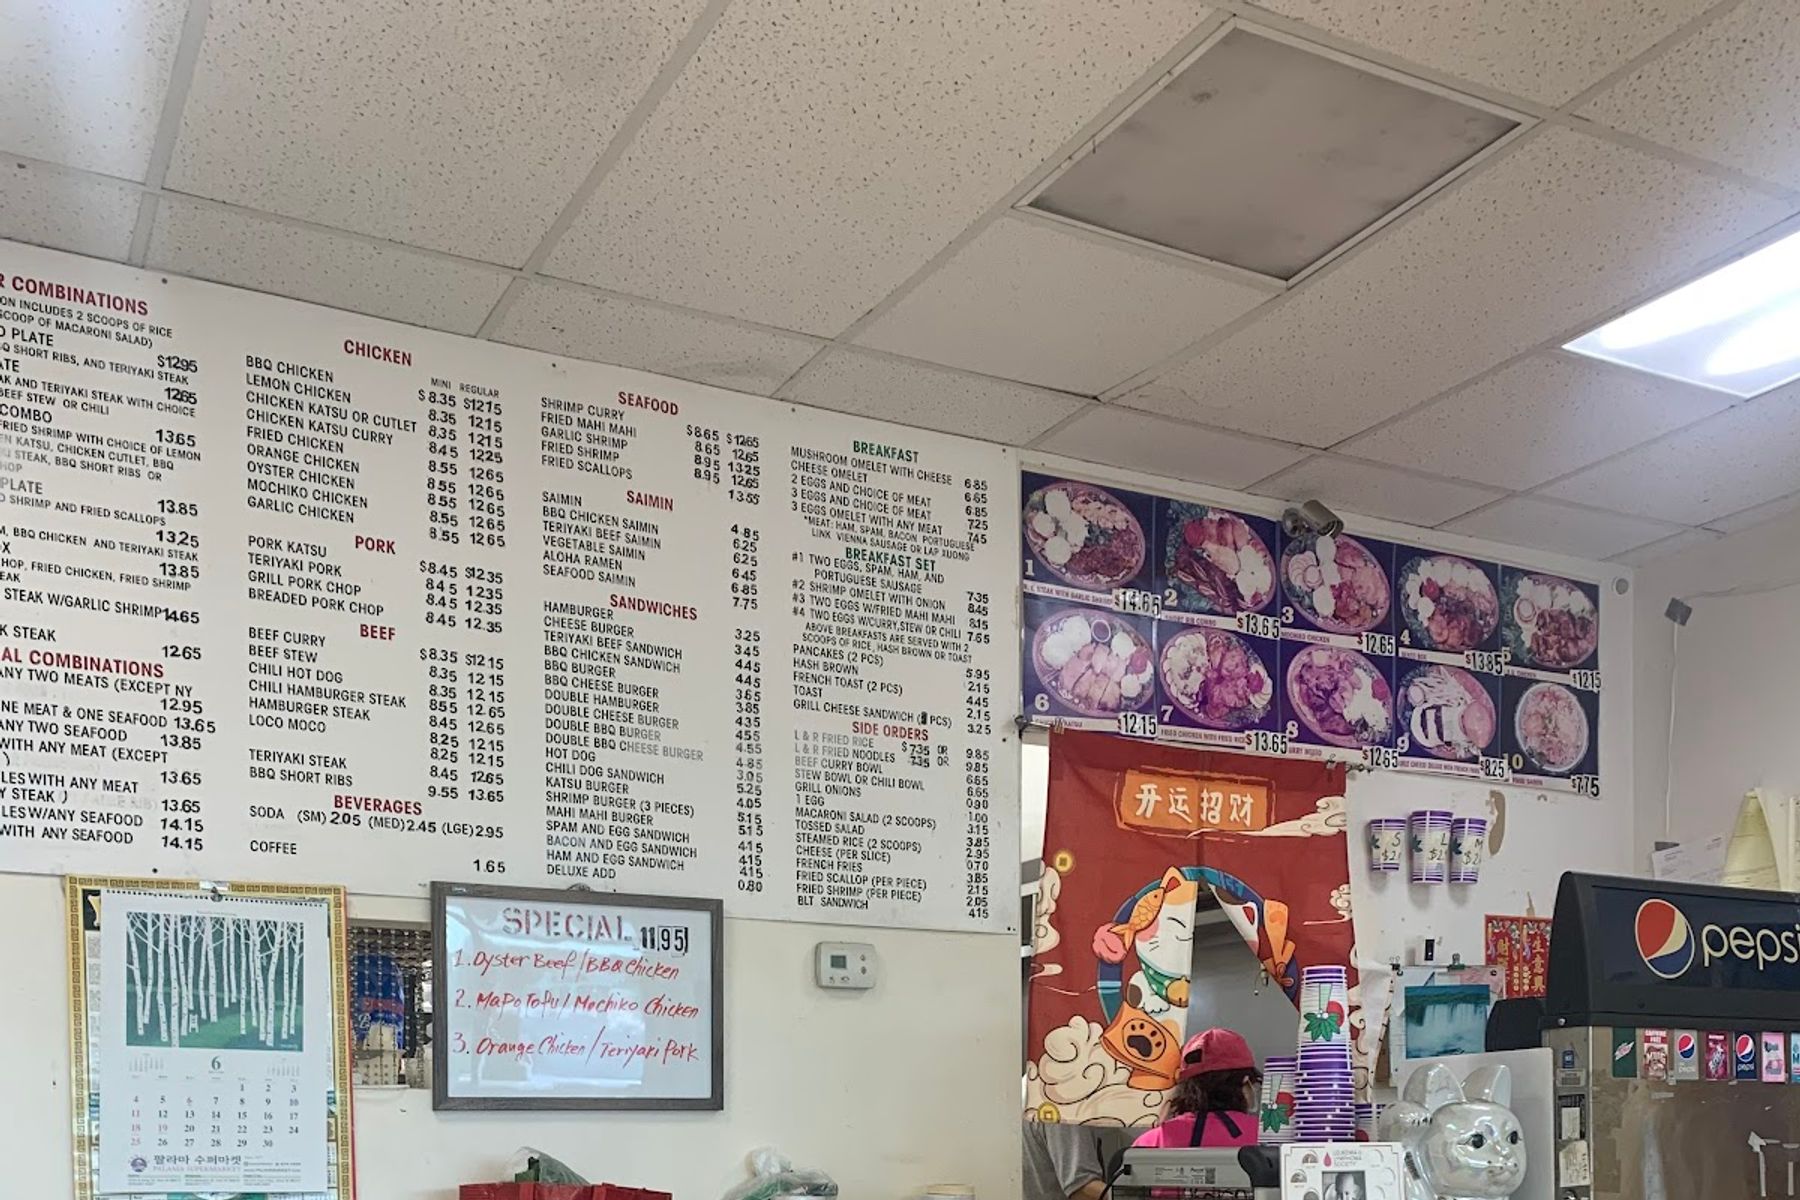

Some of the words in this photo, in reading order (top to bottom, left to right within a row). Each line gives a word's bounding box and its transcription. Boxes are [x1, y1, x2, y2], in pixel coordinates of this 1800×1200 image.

[12, 276, 149, 316] COMBINATIONS
[20, 300, 73, 318] INCLUDES
[76, 311, 83, 320] 2
[86, 312, 129, 330] SCOOPS
[133, 322, 146, 332] OF
[149, 325, 172, 338] RICE
[12, 328, 54, 346] PLATE
[344, 339, 412, 366] CHICKEN
[14, 344, 48, 360] SHORT
[52, 352, 79, 367] RIBS,
[83, 356, 105, 370] AND
[110, 362, 154, 379] TERIYAKI
[158, 371, 188, 385] STEAK
[246, 356, 273, 370] BBQ
[277, 362, 334, 382] CHICKEN
[431, 378, 451, 389] MINI
[459, 383, 500, 397] REGULAR
[246, 391, 304, 412] CHICKEN
[309, 402, 348, 420] KATSU
[352, 411, 369, 422] OR
[373, 415, 417, 432] CUTLET
[541, 398, 583, 414] SHRIMP
[588, 405, 625, 421] CURRY
[618, 392, 679, 415] SEAFOOD
[542, 412, 572, 426] FRIED
[577, 418, 605, 432] MAHI
[609, 424, 637, 438] MAHI
[247, 444, 299, 463] ORANGE
[304, 454, 359, 472] CHICKEN
[853, 441, 919, 463] BREAKFAST
[248, 478, 308, 499] MOCHIKO
[312, 489, 367, 508] CHICKEN
[542, 491, 582, 506] SAIMIN
[627, 490, 673, 511] SAIMIN
[158, 500, 198, 516] 13.85
[249, 536, 282, 551] PORK
[287, 541, 327, 557] KATSU
[355, 536, 395, 554] PORK
[543, 551, 580, 564] ALOHA
[585, 556, 622, 570] RAMEN
[846, 547, 911, 568] BREAKFAST
[916, 559, 936, 571] SET
[1025, 560, 1034, 575] 1
[610, 594, 697, 620] SANDWICHES
[1164, 590, 1177, 606] 2
[544, 601, 614, 620] HAMBURGER
[1282, 608, 1294, 622] 3
[360, 624, 396, 641] BEEF
[1237, 614, 1280, 638] $13.65
[249, 627, 279, 641] BEEF
[283, 631, 325, 648] CURRY
[1400, 630, 1410, 645] 4
[29, 651, 164, 678] COMBINATIONS
[249, 662, 282, 676] CHILI
[287, 667, 311, 679] HOT
[317, 670, 343, 683] DOG
[793, 658, 819, 671] HASH
[823, 660, 859, 675] BROWN
[28, 669, 58, 683] TWO
[64, 672, 109, 689] MEATS
[114, 678, 170, 696] (EXCEPT
[176, 686, 192, 698] NY
[160, 699, 202, 714] 12.95
[1035, 694, 1049, 711] 6
[24, 703, 58, 716] MEAT
[62, 706, 72, 718] &
[76, 708, 103, 721] ONE
[108, 713, 167, 728] SEAFOOD
[174, 718, 216, 733] 13.65
[249, 714, 283, 728] LOCO
[288, 719, 326, 733] MOCO
[1162, 706, 1174, 721] 7
[853, 721, 879, 735] SIDE
[883, 725, 929, 741] ORDERS
[1286, 721, 1298, 738] 8
[1246, 731, 1288, 754] $13.65
[1398, 738, 1409, 751] 9
[250, 767, 275, 779] BBQ
[280, 769, 321, 784] SHORT
[326, 775, 352, 786] RIBS
[334, 795, 422, 815] BEVERAGES
[1136, 784, 1254, 826] 开运招财
[250, 806, 284, 819] SODA
[298, 810, 326, 824] (SM)
[369, 816, 405, 831] (MED)
[407, 819, 436, 832] 2.45
[442, 822, 474, 837] (LGE)
[546, 821, 577, 832] SPAM
[582, 824, 605, 835] AND
[609, 826, 630, 837] EGG
[634, 828, 689, 843] SANDWICH
[250, 840, 297, 855] COFFEE
[473, 860, 505, 873] 1.65
[547, 865, 588, 877] DELUXE
[592, 867, 616, 879] ADD
[798, 896, 813, 906] BLT
[821, 897, 868, 909] SANDWICH
[502, 908, 632, 941] SPECIAL
[473, 951, 530, 976] Oyster
[626, 957, 678, 980] Chicken
[644, 994, 698, 1018] Chicken
[477, 1037, 534, 1060] Orange
[661, 1039, 698, 1064] Pork
[211, 1056, 221, 1070] 6
[290, 1112, 298, 1120] 17
[289, 1126, 298, 1134] 24
[154, 1155, 189, 1165] 팔라마
[195, 1155, 241, 1164] 수퍼마켓
